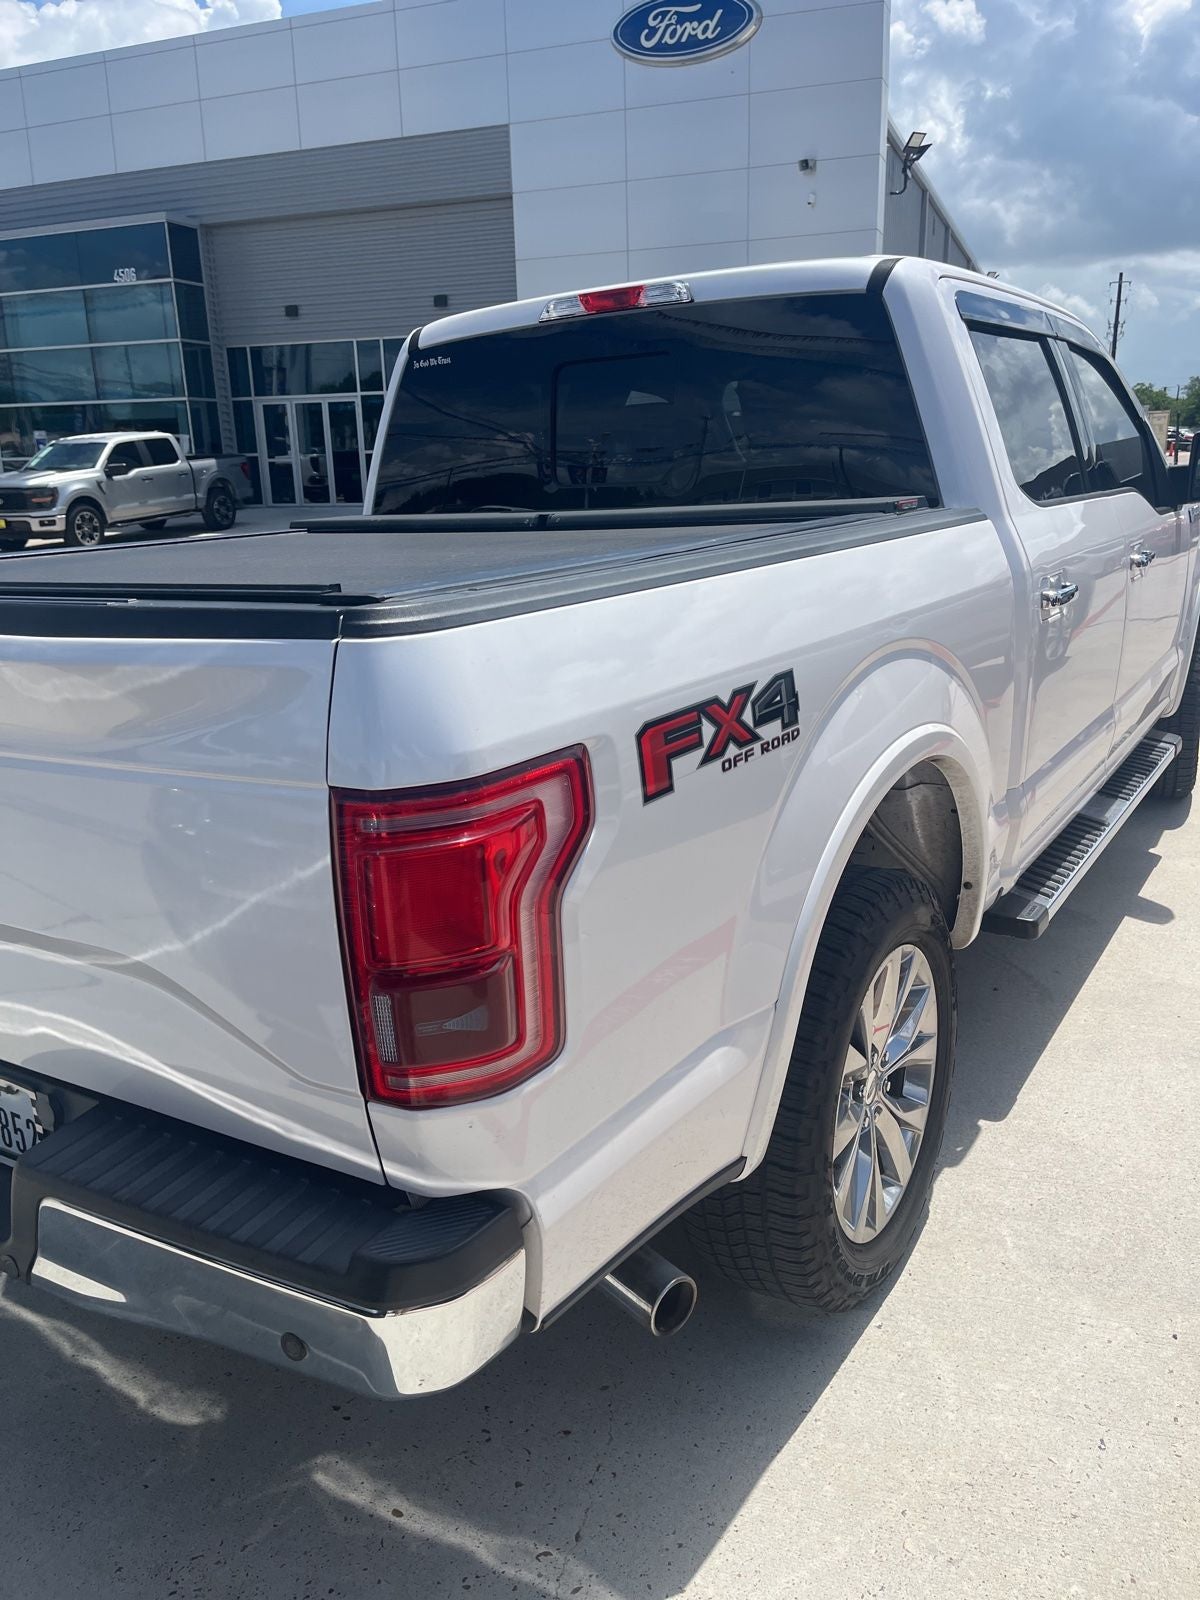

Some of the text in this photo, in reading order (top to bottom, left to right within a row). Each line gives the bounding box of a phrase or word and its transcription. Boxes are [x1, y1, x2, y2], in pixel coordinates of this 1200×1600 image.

[640, 4, 723, 48] Ford
[113, 267, 137, 283] 4506
[438, 356, 451, 365] Trust
[635, 668, 800, 807] FX4
[721, 727, 800, 773] OFF ROAD
